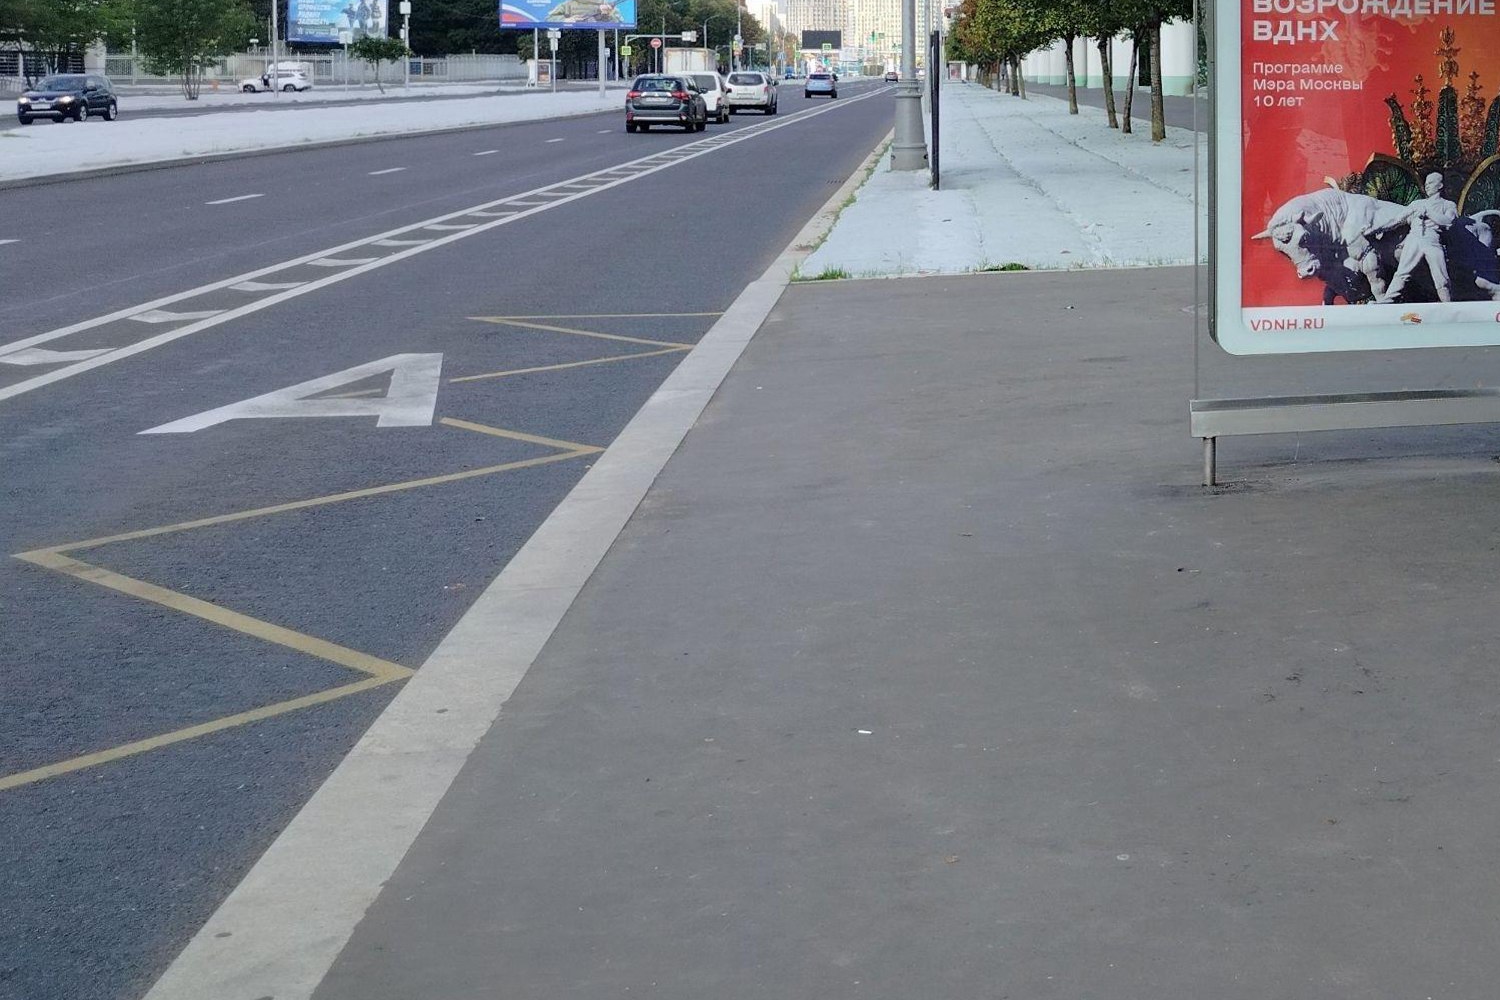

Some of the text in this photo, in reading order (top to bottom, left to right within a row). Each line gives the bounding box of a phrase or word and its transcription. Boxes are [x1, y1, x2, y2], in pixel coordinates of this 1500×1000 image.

[1253, 20, 1340, 46] ВДНХ
[1253, 62, 1344, 79] Программе
[1253, 78, 1364, 94] Мэра Москвы
[1253, 96, 1305, 107] 10 лет
[1250, 317, 1325, 332] VDNH.RU
